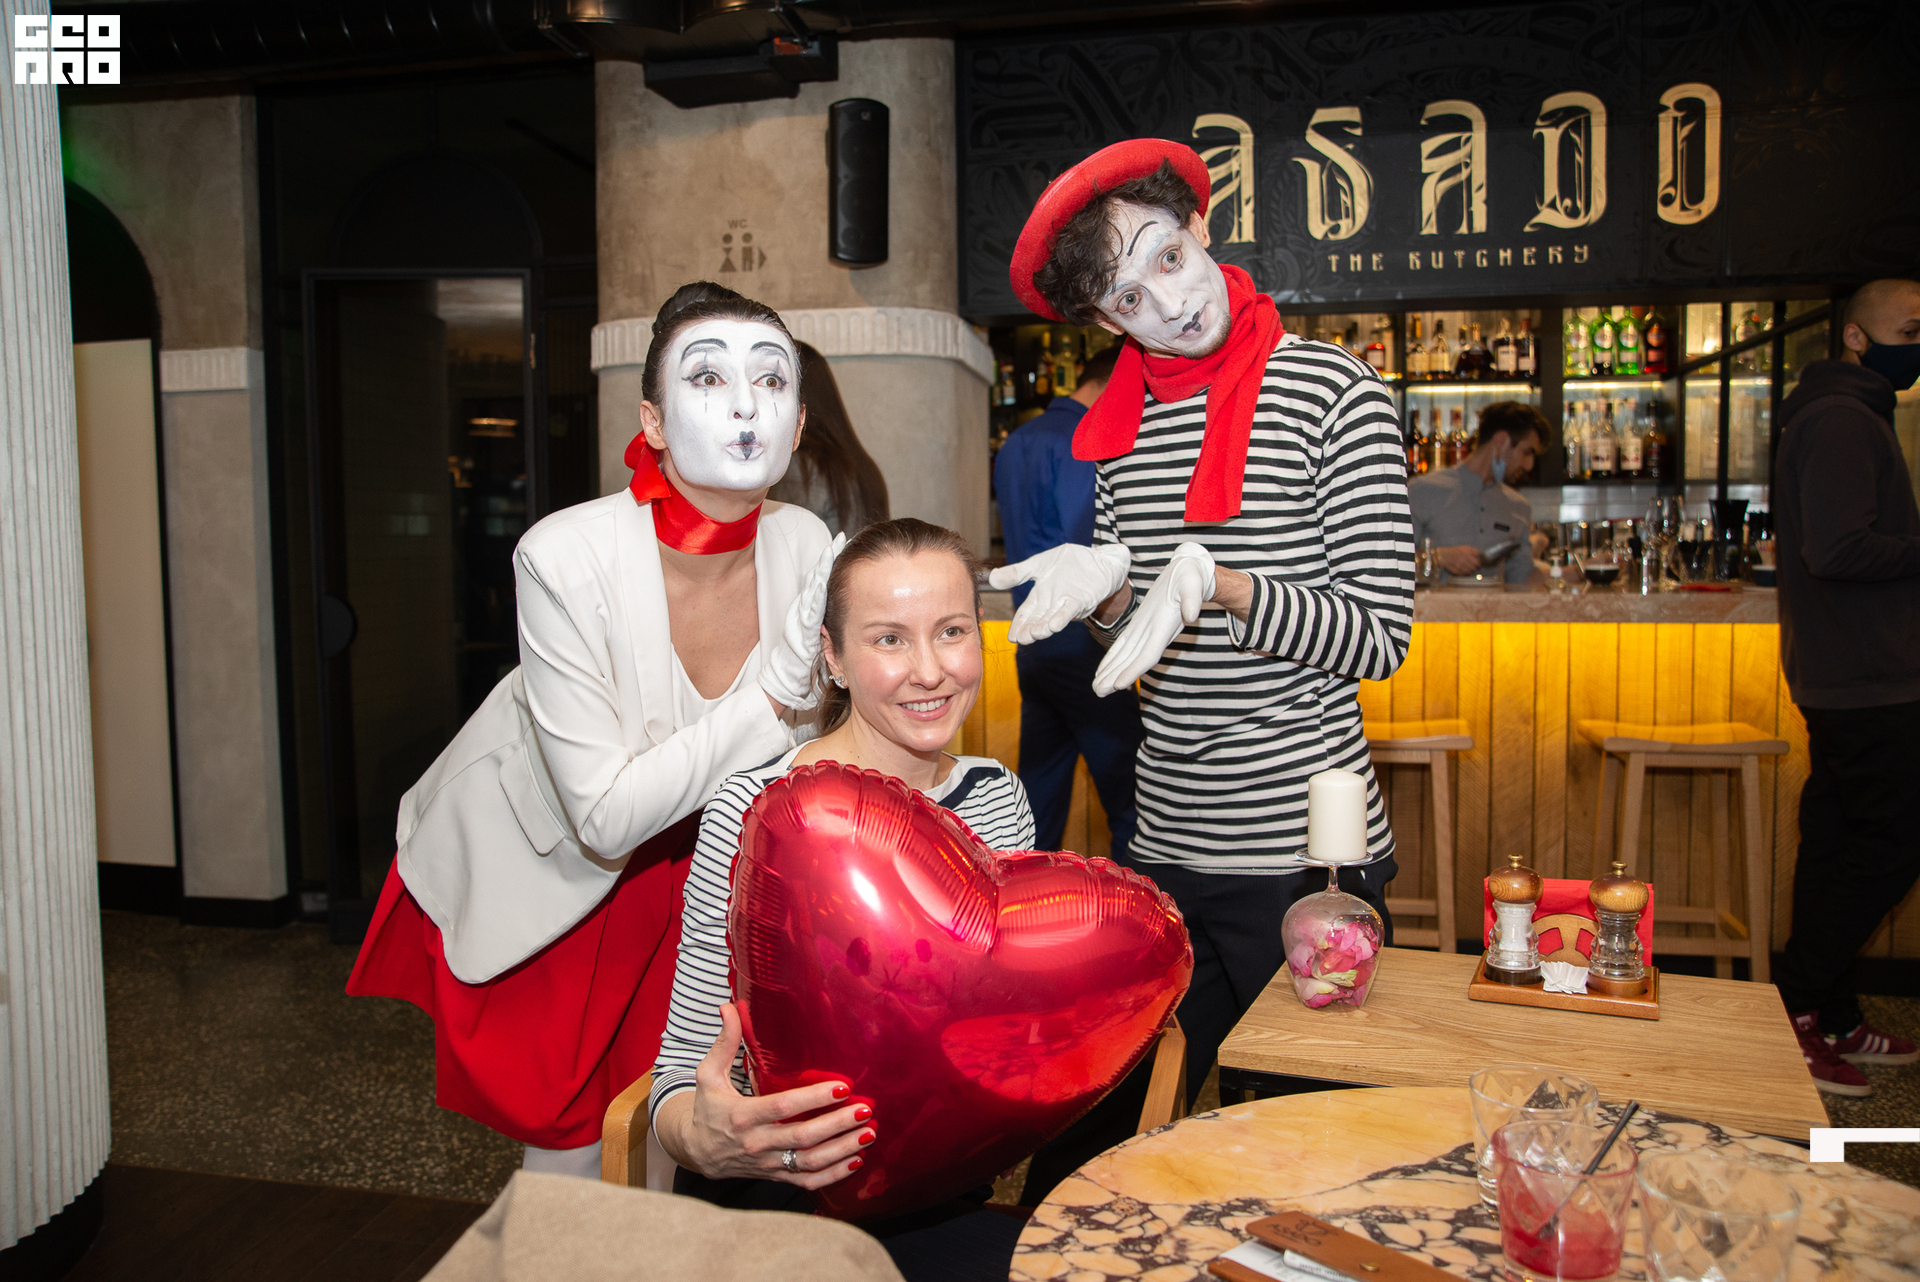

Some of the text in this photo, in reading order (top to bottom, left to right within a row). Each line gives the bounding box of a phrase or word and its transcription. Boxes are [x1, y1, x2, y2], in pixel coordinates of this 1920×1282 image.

[727, 218, 748, 229] WC
[1328, 245, 1589, 272] THE BUTCHERY
